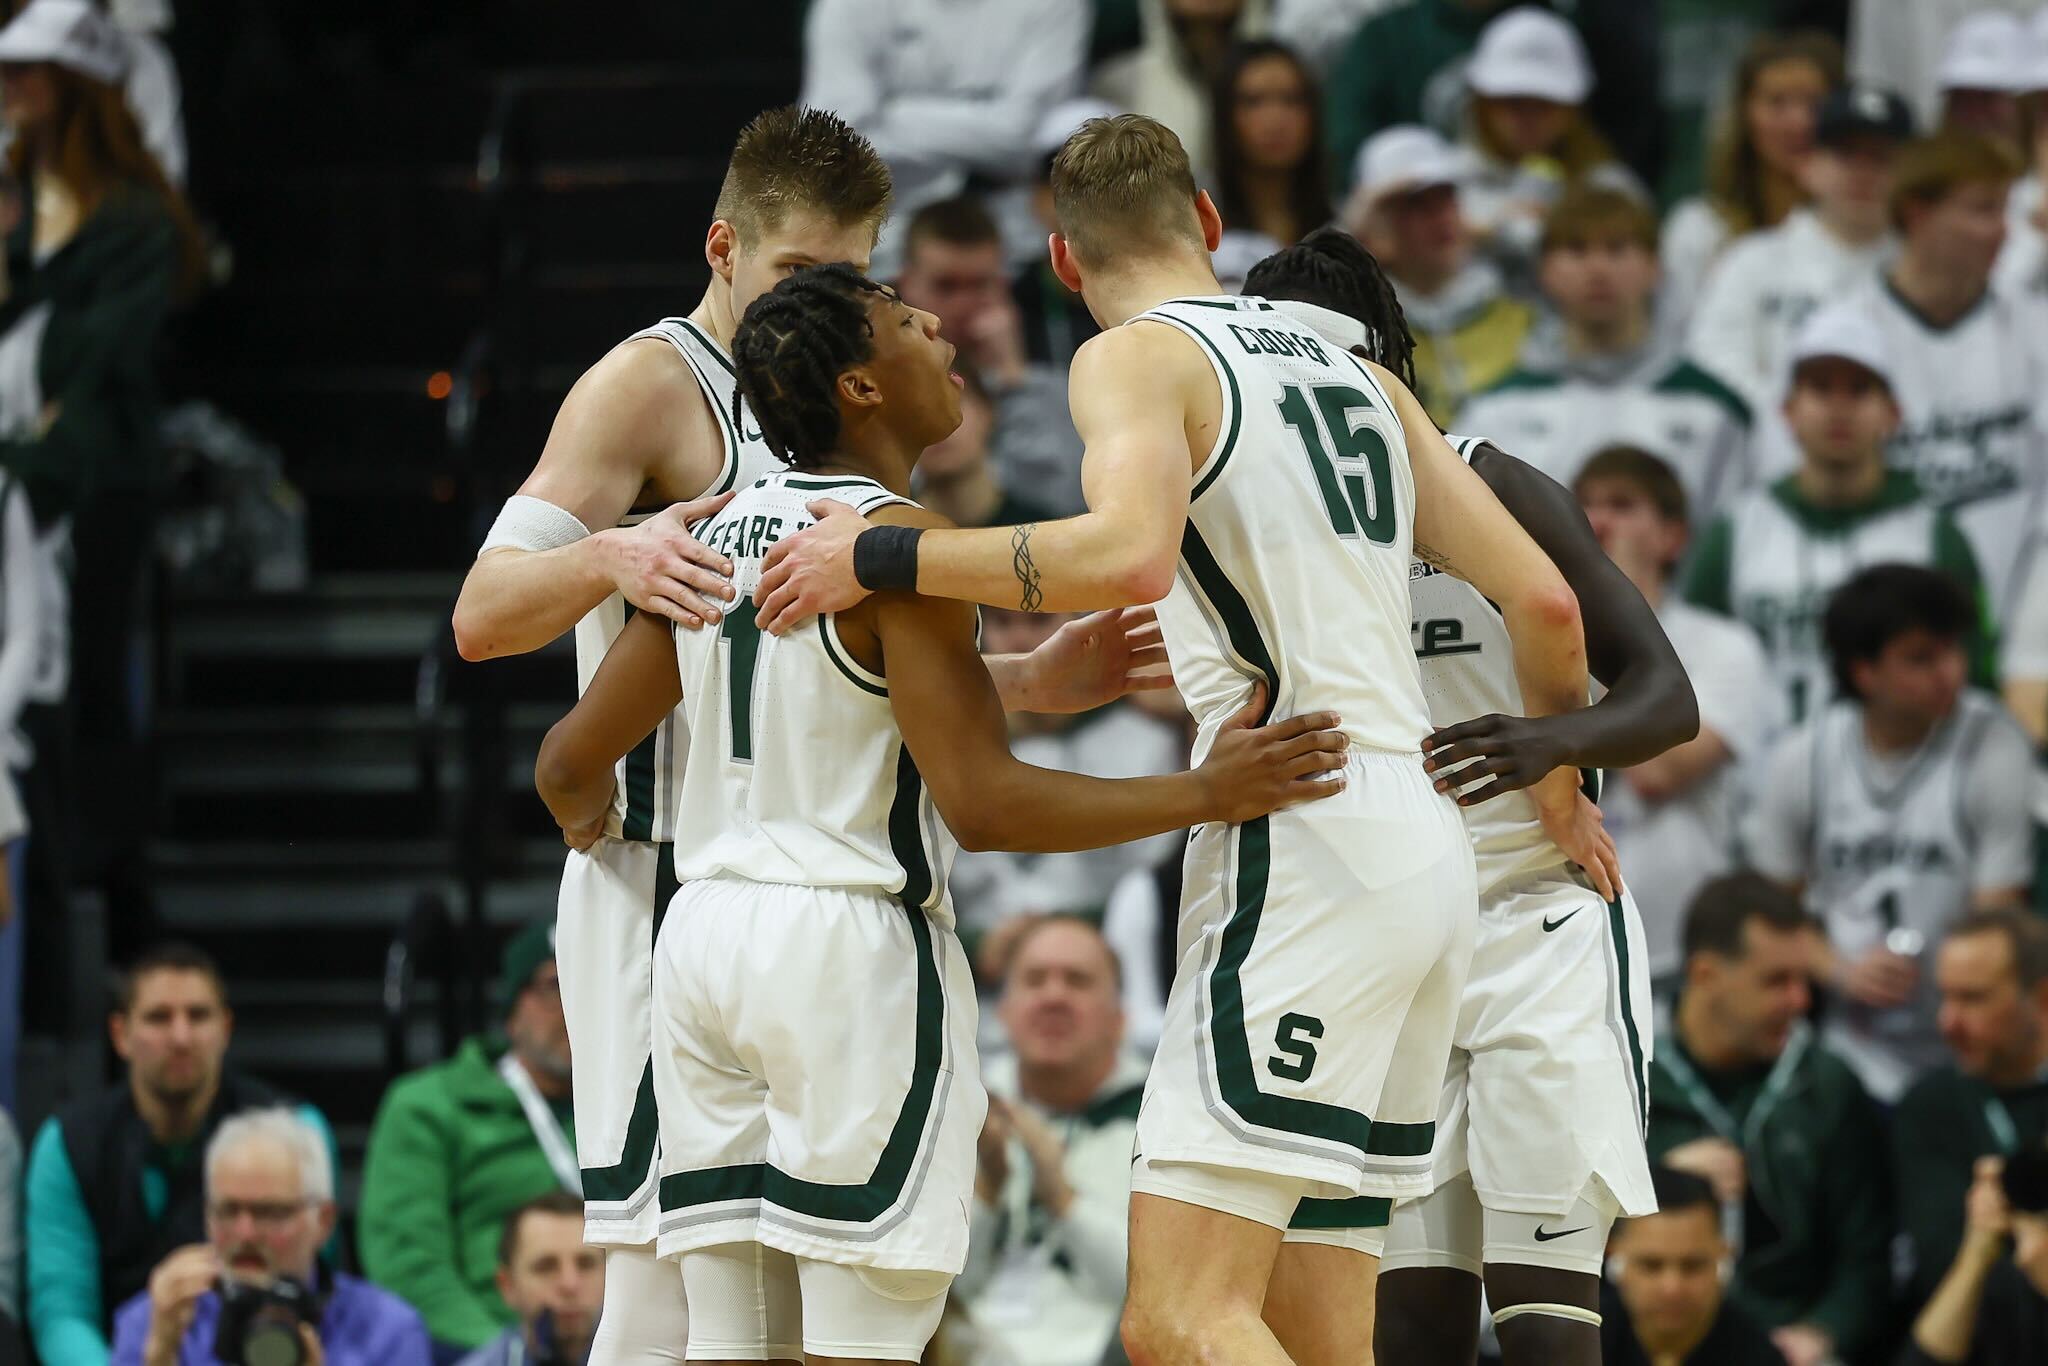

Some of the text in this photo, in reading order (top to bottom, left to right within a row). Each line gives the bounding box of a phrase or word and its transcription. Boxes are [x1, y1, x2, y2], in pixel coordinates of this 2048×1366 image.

[1226, 323, 1337, 368] COOPER
[1274, 381, 1399, 549] 15
[718, 590, 764, 766] 1
[1267, 1011, 1325, 1084] S
